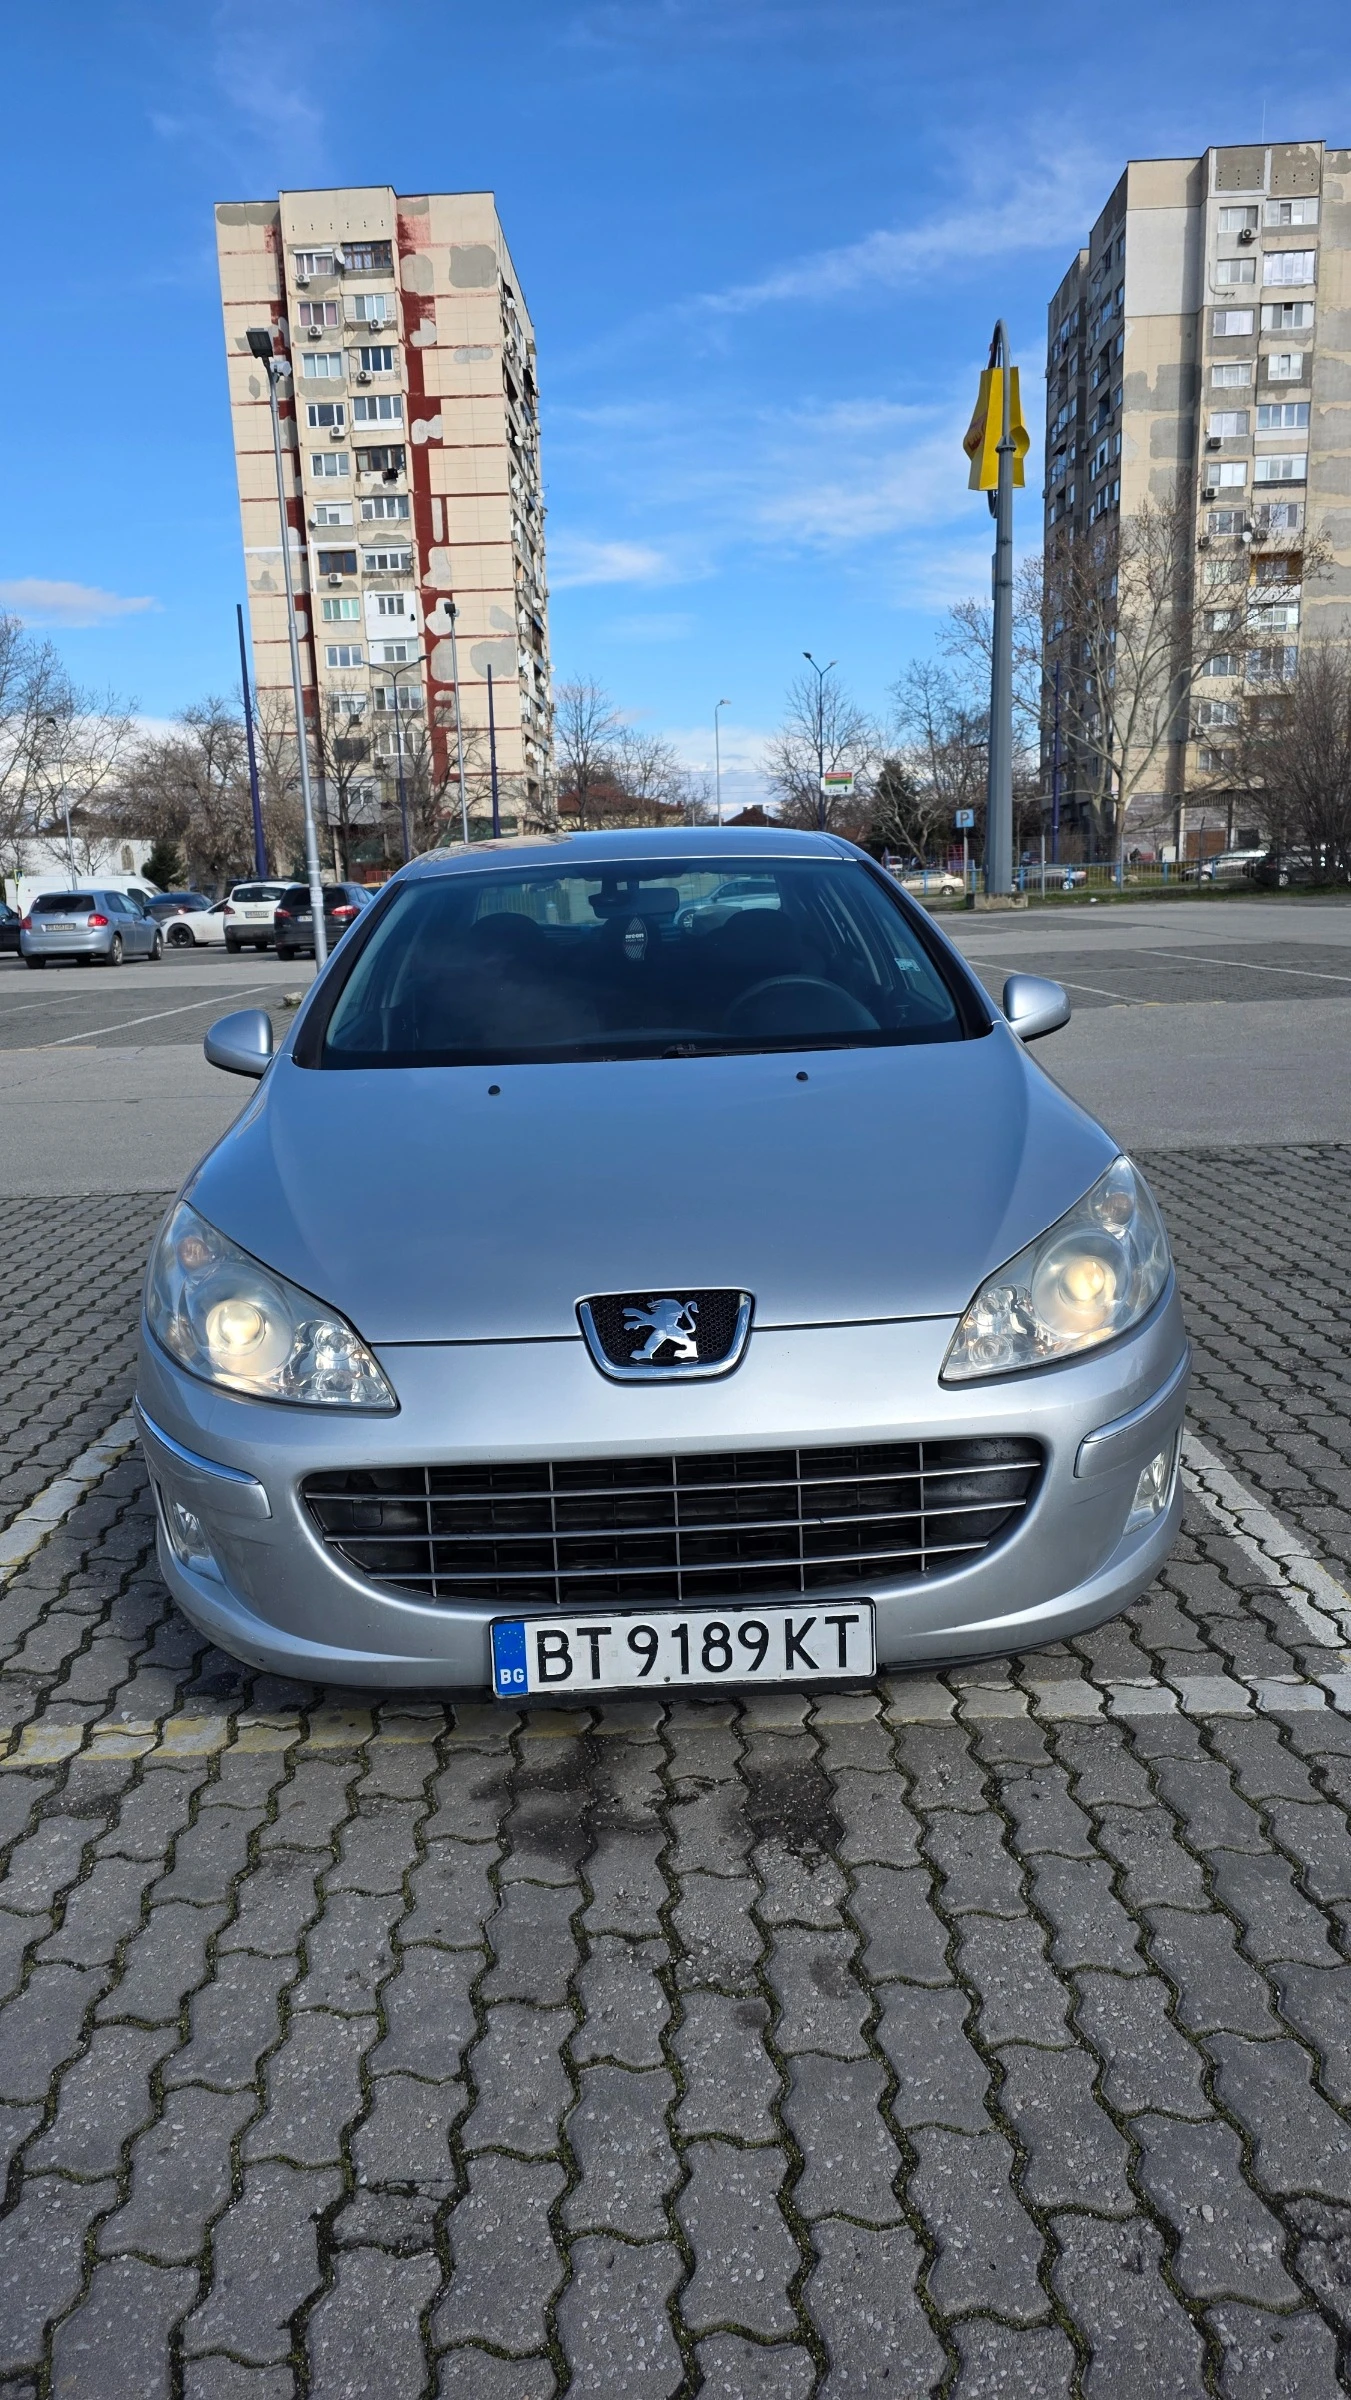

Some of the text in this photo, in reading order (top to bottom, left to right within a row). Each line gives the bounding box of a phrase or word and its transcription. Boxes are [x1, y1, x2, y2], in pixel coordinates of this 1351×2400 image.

[960, 811, 970, 826] P
[536, 1614, 860, 1683] BT 9189 KT
[500, 1668, 525, 1685] BG
